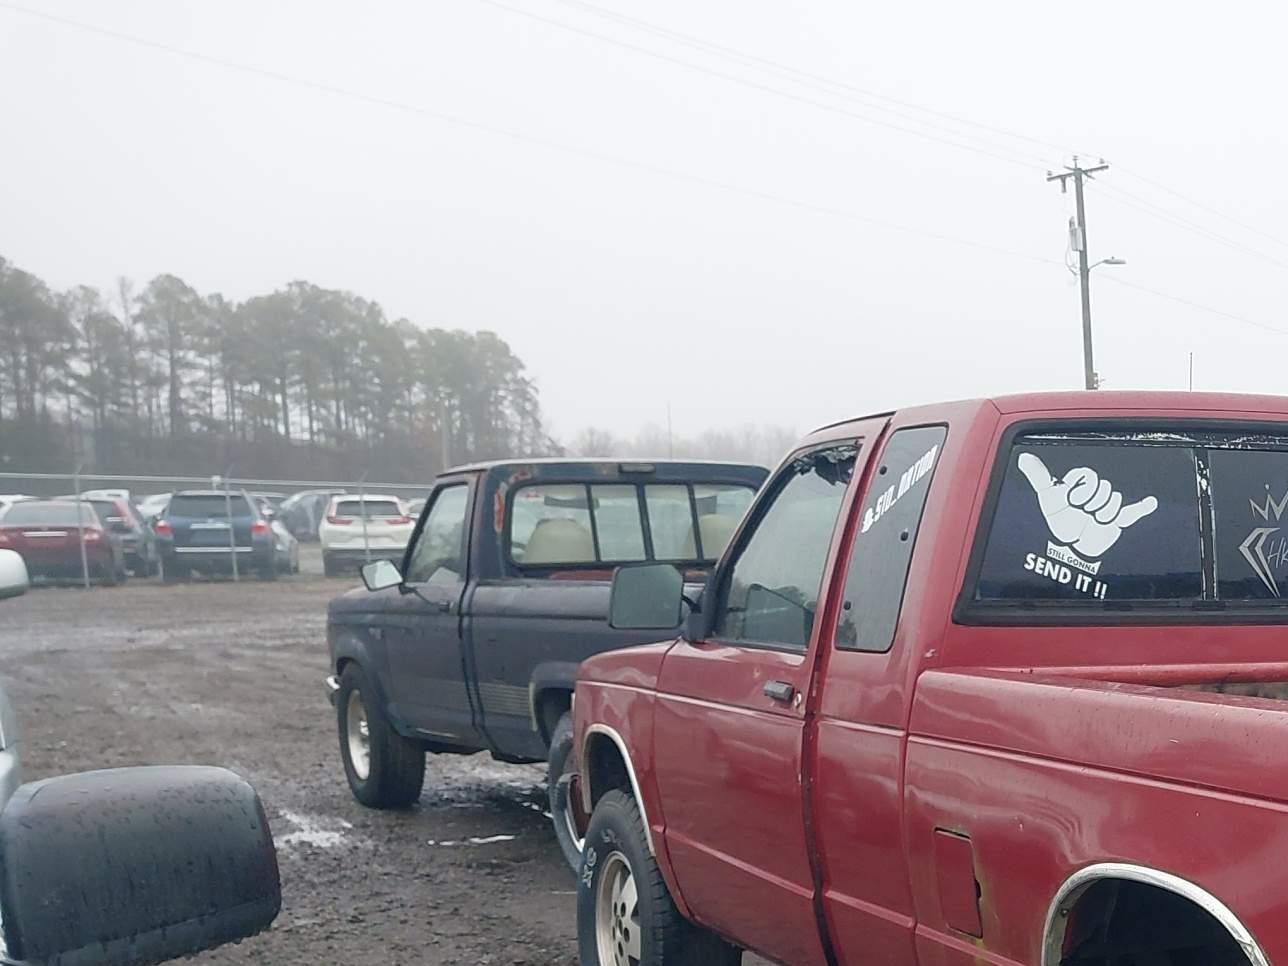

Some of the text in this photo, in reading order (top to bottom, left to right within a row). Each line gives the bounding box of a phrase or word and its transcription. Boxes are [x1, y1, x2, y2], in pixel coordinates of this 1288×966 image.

[1023, 552, 1072, 584] SEND
[1075, 573, 1092, 592] IT
[1048, 548, 1096, 573] STILL GONNA
